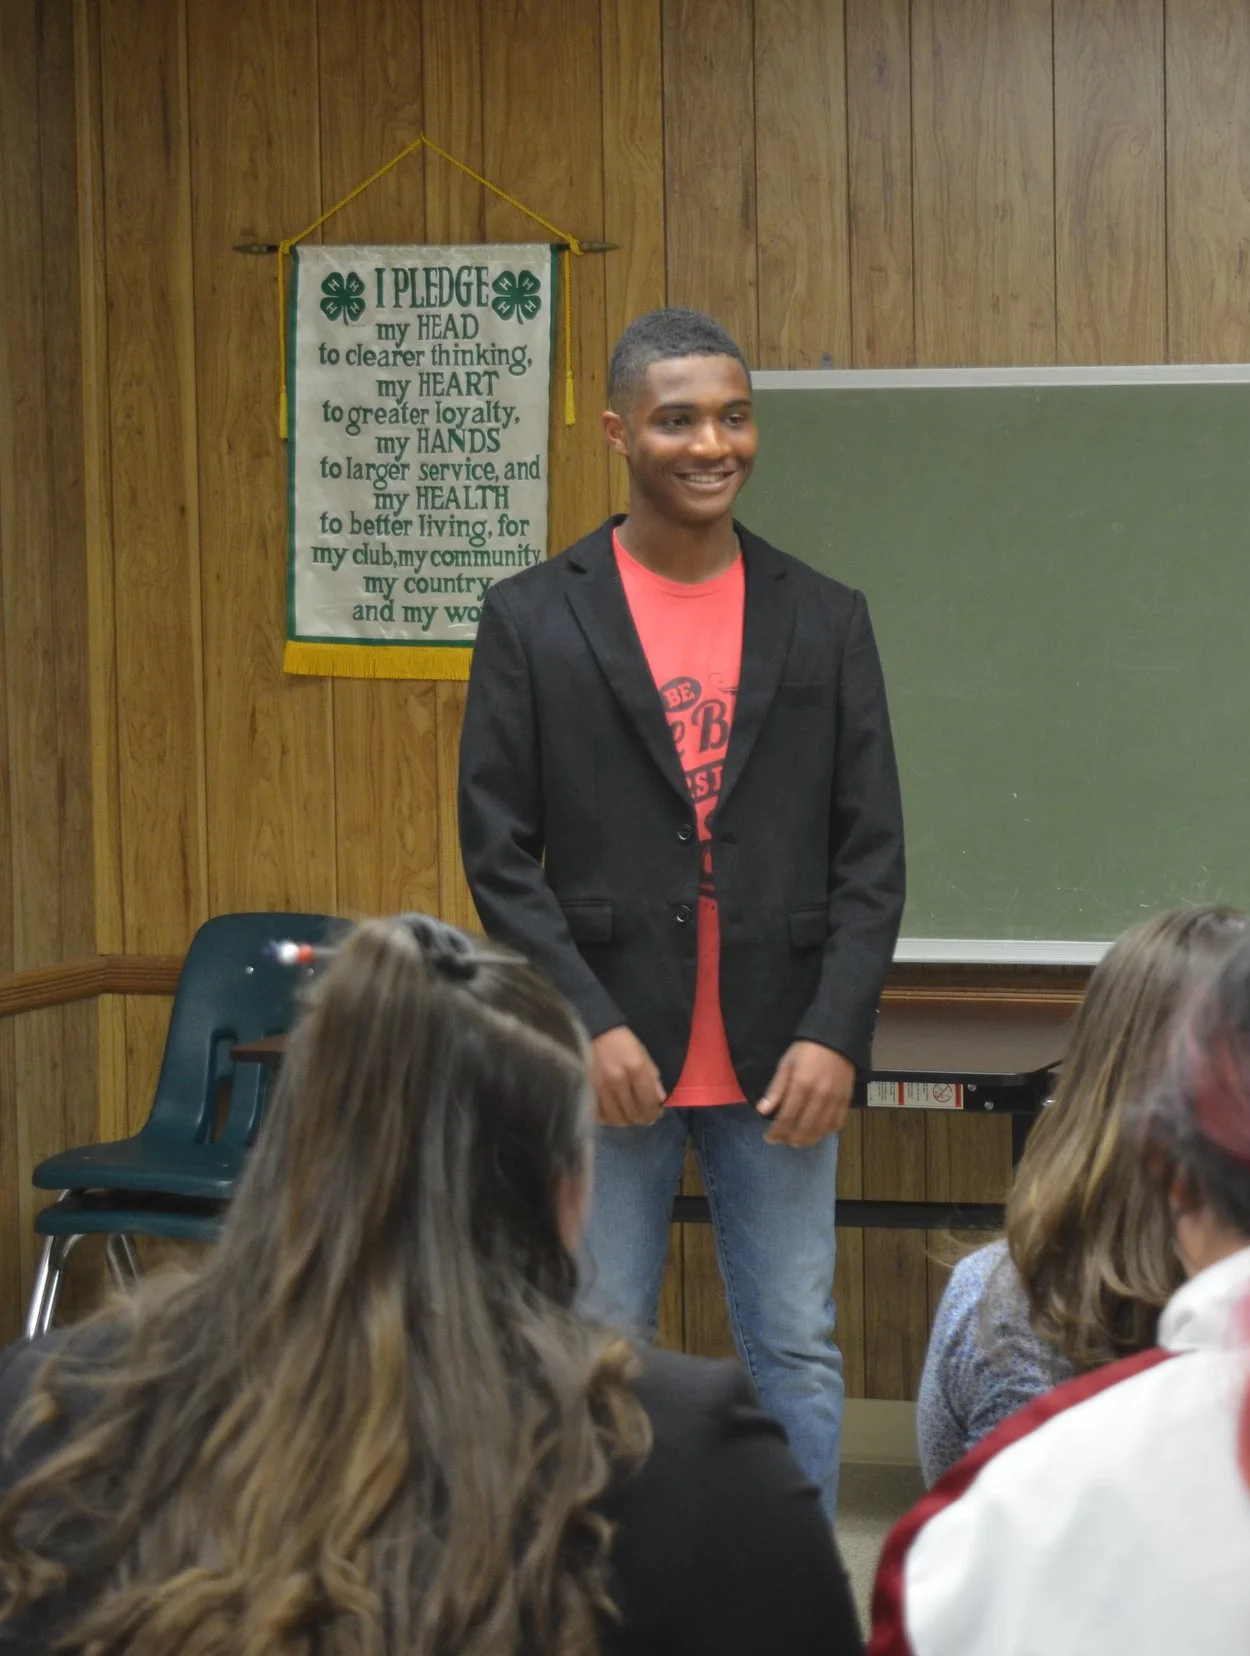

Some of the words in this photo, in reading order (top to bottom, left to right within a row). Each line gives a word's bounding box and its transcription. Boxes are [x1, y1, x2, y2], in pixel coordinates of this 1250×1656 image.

[328, 279, 340, 291] H
[350, 280, 359, 292] H
[375, 267, 387, 308] I
[392, 266, 489, 308] PLEDGE
[499, 278, 512, 290] H
[523, 278, 534, 290] H
[327, 302, 338, 314] H
[350, 301, 360, 314] H
[498, 301, 510, 313] H
[525, 300, 536, 312] H
[376, 322, 410, 347] my
[417, 313, 479, 340] HEAD
[318, 343, 340, 366] to
[346, 344, 425, 367] clearer
[431, 343, 533, 376] thinking,
[376, 379, 411, 404] my
[419, 371, 500, 397] HEART
[322, 400, 344, 423] to
[345, 402, 430, 436] greater
[435, 400, 520, 429] loyalty,
[376, 436, 410, 460] my
[417, 427, 500, 454] HANDS
[320, 456, 342, 479] to
[347, 457, 410, 490] larger
[418, 458, 500, 483] service,
[503, 455, 541, 480] and
[373, 491, 410, 517] my
[416, 485, 510, 510] HEALTH
[320, 511, 343, 535] to
[350, 510, 413, 537] better
[419, 514, 493, 547] living,
[497, 514, 530, 537] for
[310, 544, 350, 571] my
[352, 543, 398, 568] club,
[398, 549, 429, 574] my
[363, 575, 399, 600] my
[404, 573, 494, 601] country
[352, 599, 395, 622] and
[401, 605, 438, 631] my
[444, 605, 483, 623] wo
[663, 681, 696, 710] BE
